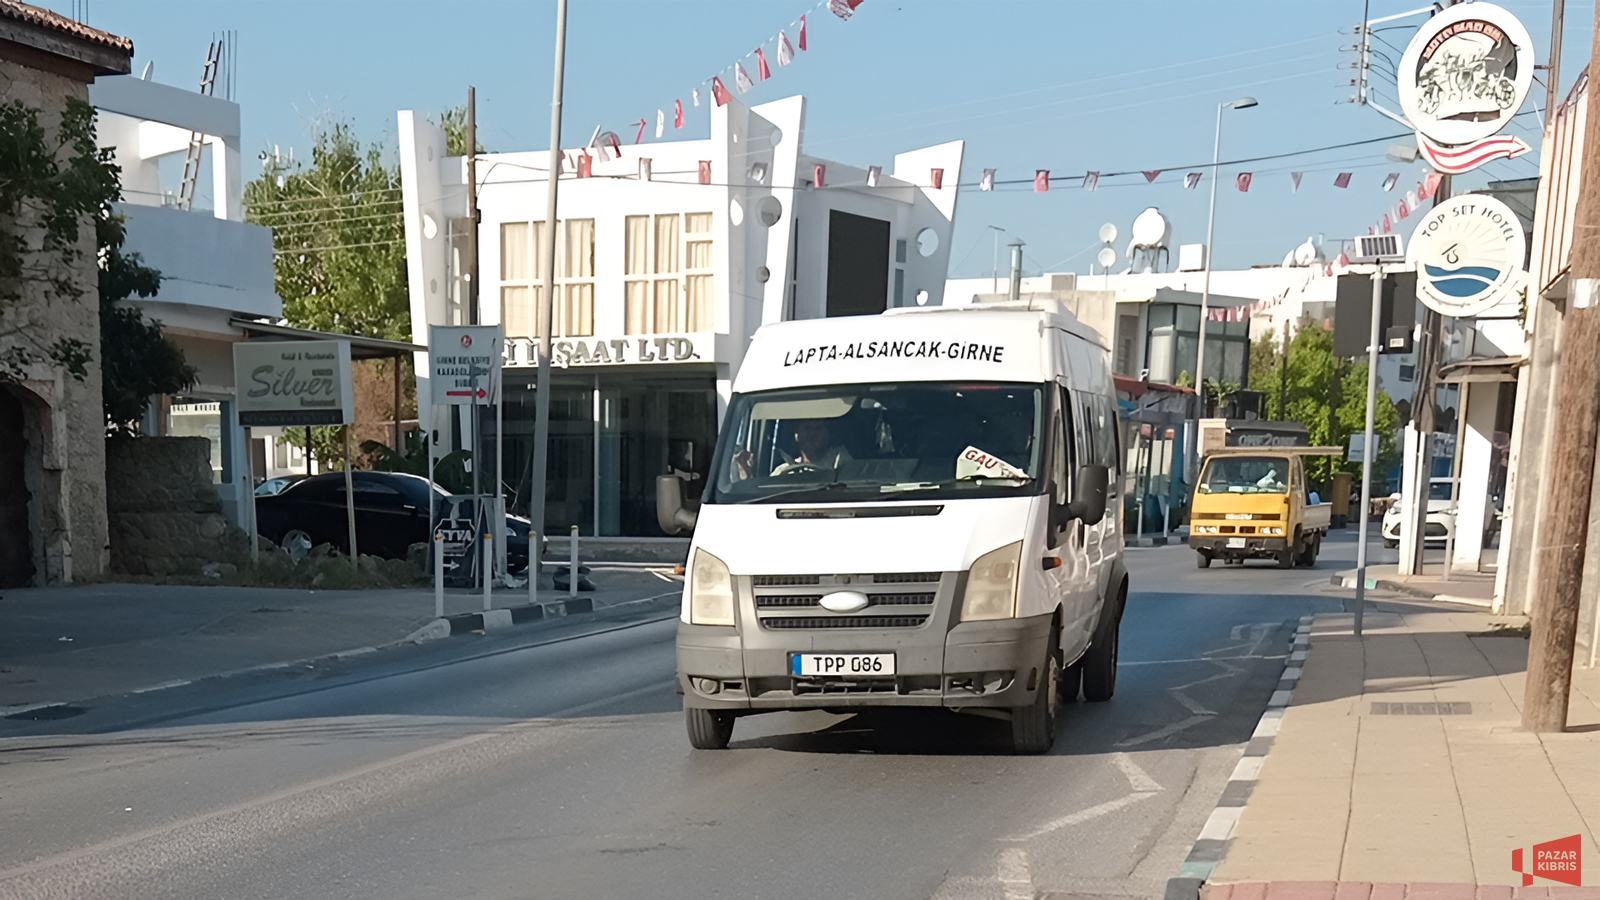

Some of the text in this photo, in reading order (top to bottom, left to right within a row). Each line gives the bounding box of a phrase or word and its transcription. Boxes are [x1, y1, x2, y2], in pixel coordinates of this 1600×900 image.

[1422, 205, 1515, 242] TOP SET HOTEL
[246, 364, 335, 398] Silver
[965, 449, 999, 469] GAU
[813, 656, 882, 673] TPP 086
